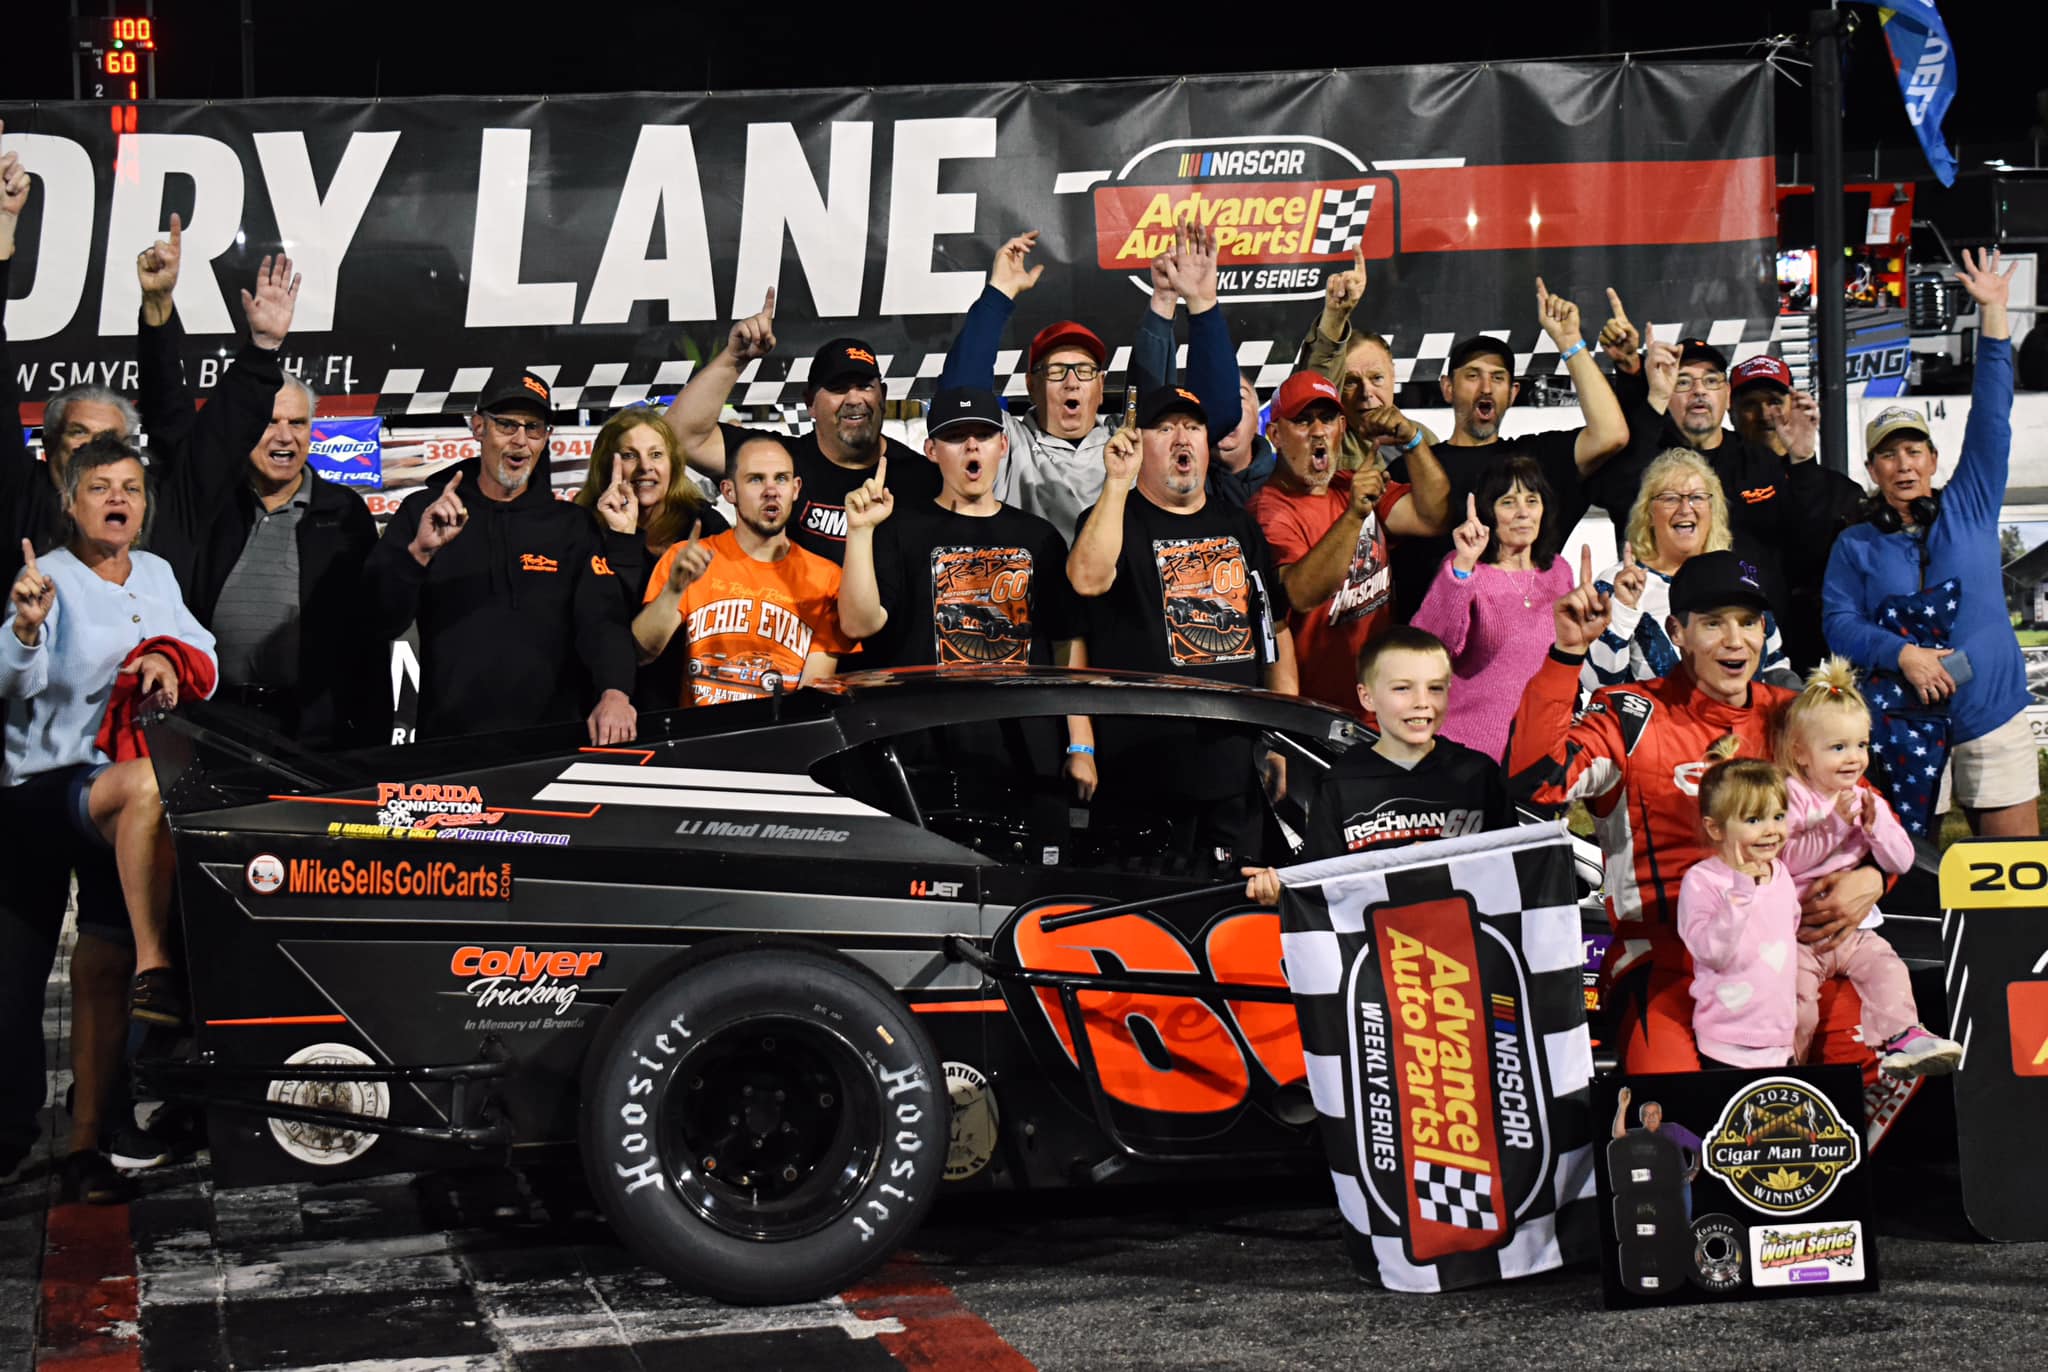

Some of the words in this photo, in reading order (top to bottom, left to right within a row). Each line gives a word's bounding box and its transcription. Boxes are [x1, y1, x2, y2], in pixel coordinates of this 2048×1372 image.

[114, 18, 151, 40] 100
[105, 51, 136, 73] 60
[95, 84, 104, 98] 2
[129, 80, 138, 101] 1
[1210, 150, 1306, 177] NASCAR
[464, 117, 998, 328] LANE
[1136, 191, 1307, 229] Advance
[1214, 226, 1300, 256] Parts
[1254, 268, 1320, 289] SERIES
[324, 355, 360, 387] FL
[311, 442, 377, 455] SUNOCO
[342, 471, 381, 484] FUELS
[991, 570, 1029, 603] 60
[1213, 558, 1246, 594] 60
[387, 799, 482, 813] CONNECTION
[702, 821, 757, 838] Mod
[760, 824, 850, 843] Maniac
[289, 858, 499, 898] MikeSellsGolfCarts
[1969, 861, 2048, 892] 20
[451, 946, 603, 982] Colyer
[1386, 927, 1432, 1031] Auto
[466, 974, 580, 1016] Trucking
[464, 1019, 476, 1030] In
[478, 1019, 526, 1032] Memory
[528, 1018, 542, 1030] of
[1360, 1002, 1390, 1091] WEEKLY
[1425, 946, 1481, 1153] Advance
[944, 1066, 987, 1091] ATION
[1403, 1033, 1446, 1146] Parts
[1494, 1031, 1535, 1150] NASCAR
[615, 1013, 692, 1195] Hoosier
[1756, 1089, 1800, 1105] 2025
[1369, 1093, 1397, 1172] SERIES
[853, 1063, 931, 1242] Hoosier
[1715, 1148, 1761, 1165] Cigar
[1767, 1145, 1802, 1160] Man
[1809, 1144, 1847, 1158] Tour
[1753, 1183, 1816, 1205] WINNER
[1761, 1238, 1804, 1263] World
[1807, 1231, 1857, 1254] Series
